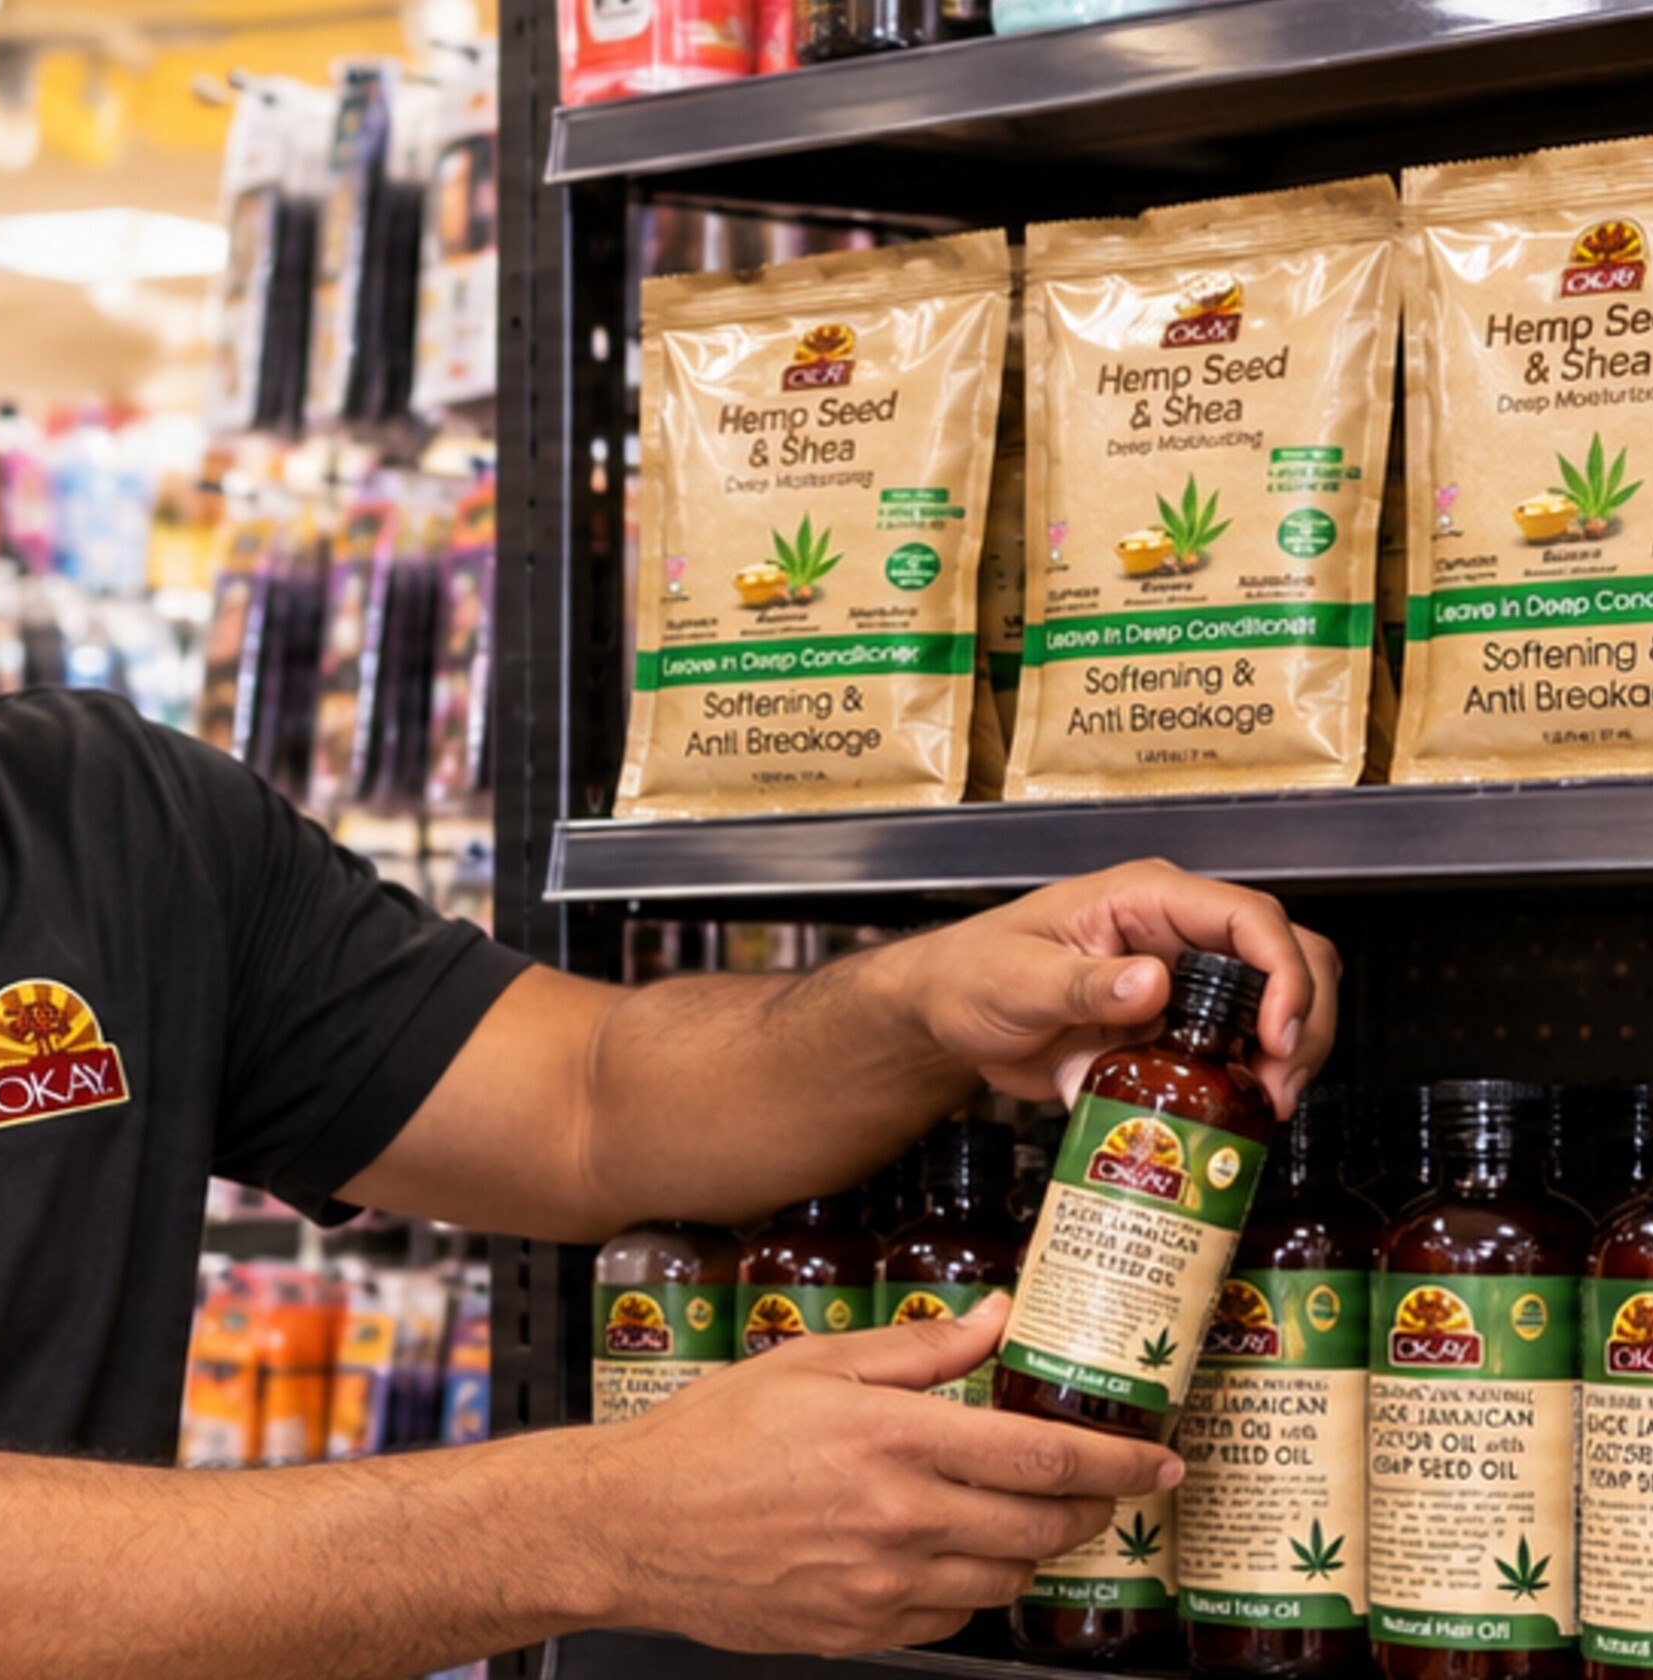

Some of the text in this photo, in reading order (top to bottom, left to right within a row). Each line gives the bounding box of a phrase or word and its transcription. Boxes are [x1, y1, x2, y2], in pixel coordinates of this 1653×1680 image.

[1485, 312, 1593, 349] Hemp
[1098, 346, 1289, 397] Hemp Seed
[1524, 348, 1652, 385] & Shea
[718, 390, 898, 436] Hemp Seed
[1130, 395, 1242, 430] & Shea
[749, 436, 856, 467] & Shea
[1435, 602, 1496, 623] Leave
[1526, 595, 1589, 617] Deep
[1484, 637, 1636, 673] Softening
[1085, 658, 1255, 695] Softening &
[704, 685, 863, 719] Softening &
[1464, 682, 1525, 715] Anti
[1067, 700, 1274, 736] Anti Breakage
[685, 727, 880, 757] Anti Breakage
[1275, 1446, 1313, 1465] OIL
[1480, 1460, 1518, 1479] OIL
